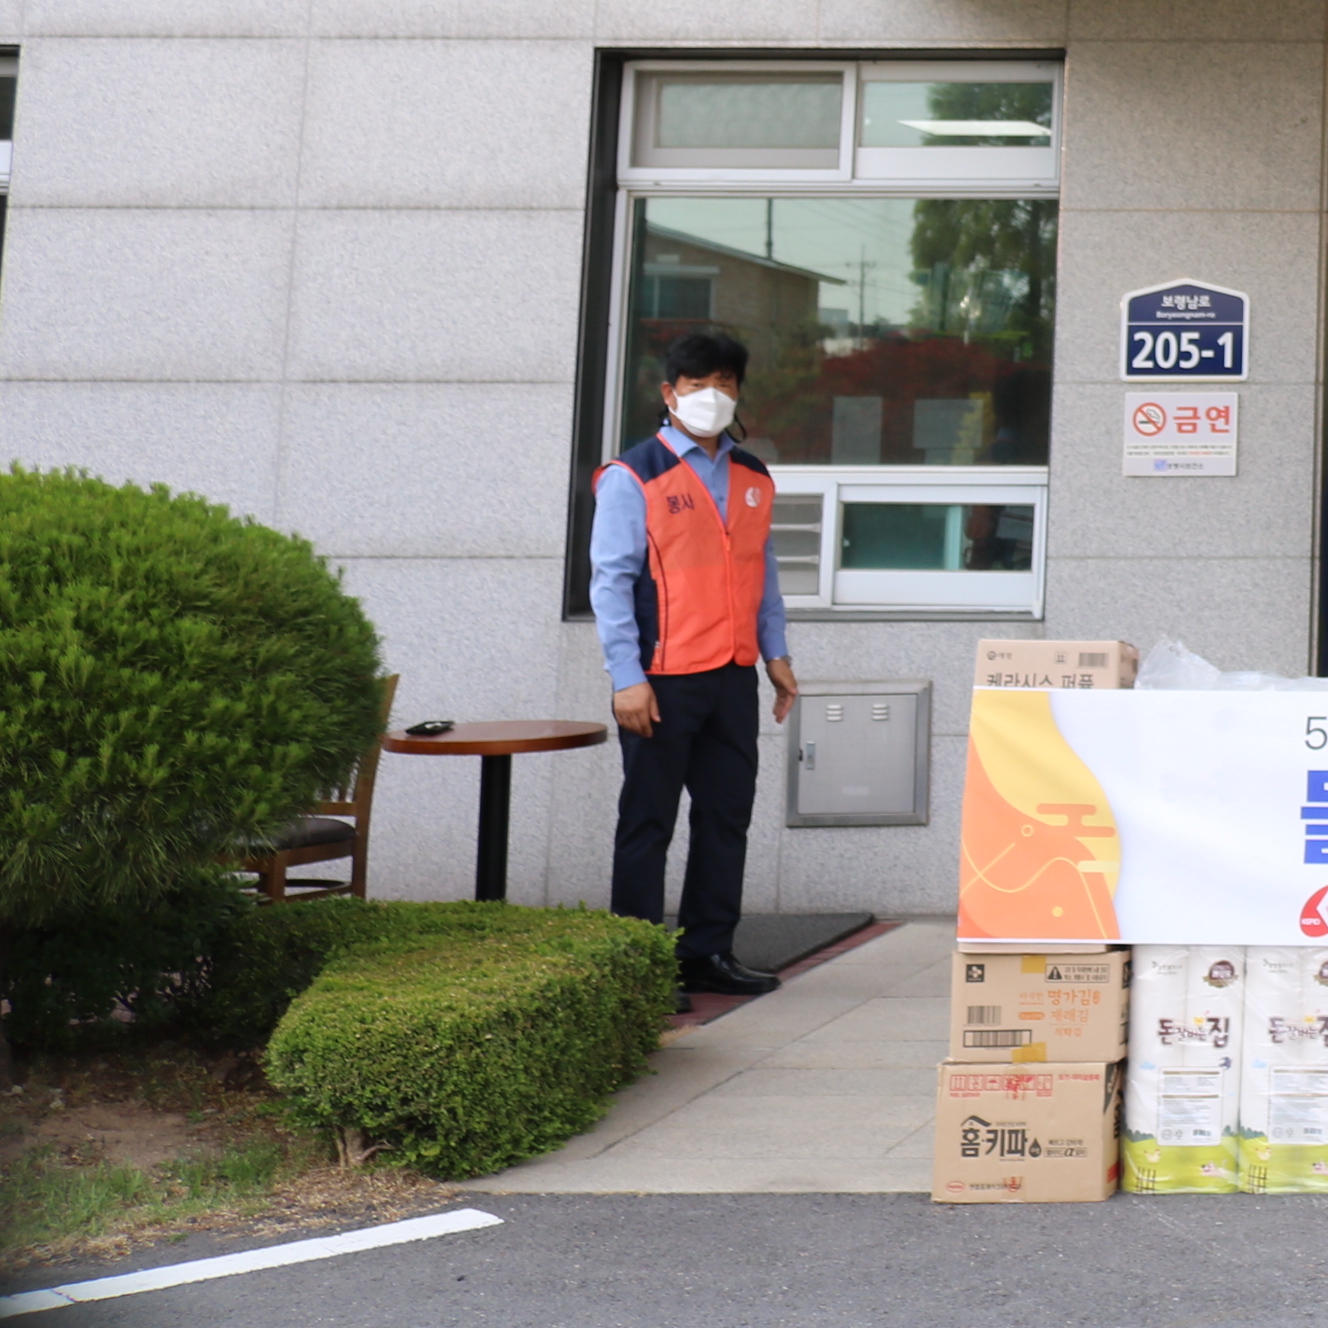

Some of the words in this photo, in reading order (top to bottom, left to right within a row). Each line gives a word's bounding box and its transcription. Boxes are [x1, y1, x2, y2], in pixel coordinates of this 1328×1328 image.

[1156, 311, 1215, 320] Boryeongnam-ro
[1161, 295, 1211, 310] 보령남로
[1132, 331, 1233, 369] 205-1
[1173, 405, 1230, 434] 금연
[667, 493, 695, 514] 봉사
[1158, 1018, 1173, 1045] 돈
[1207, 1017, 1230, 1048] 집
[1269, 1017, 1284, 1043] 돈
